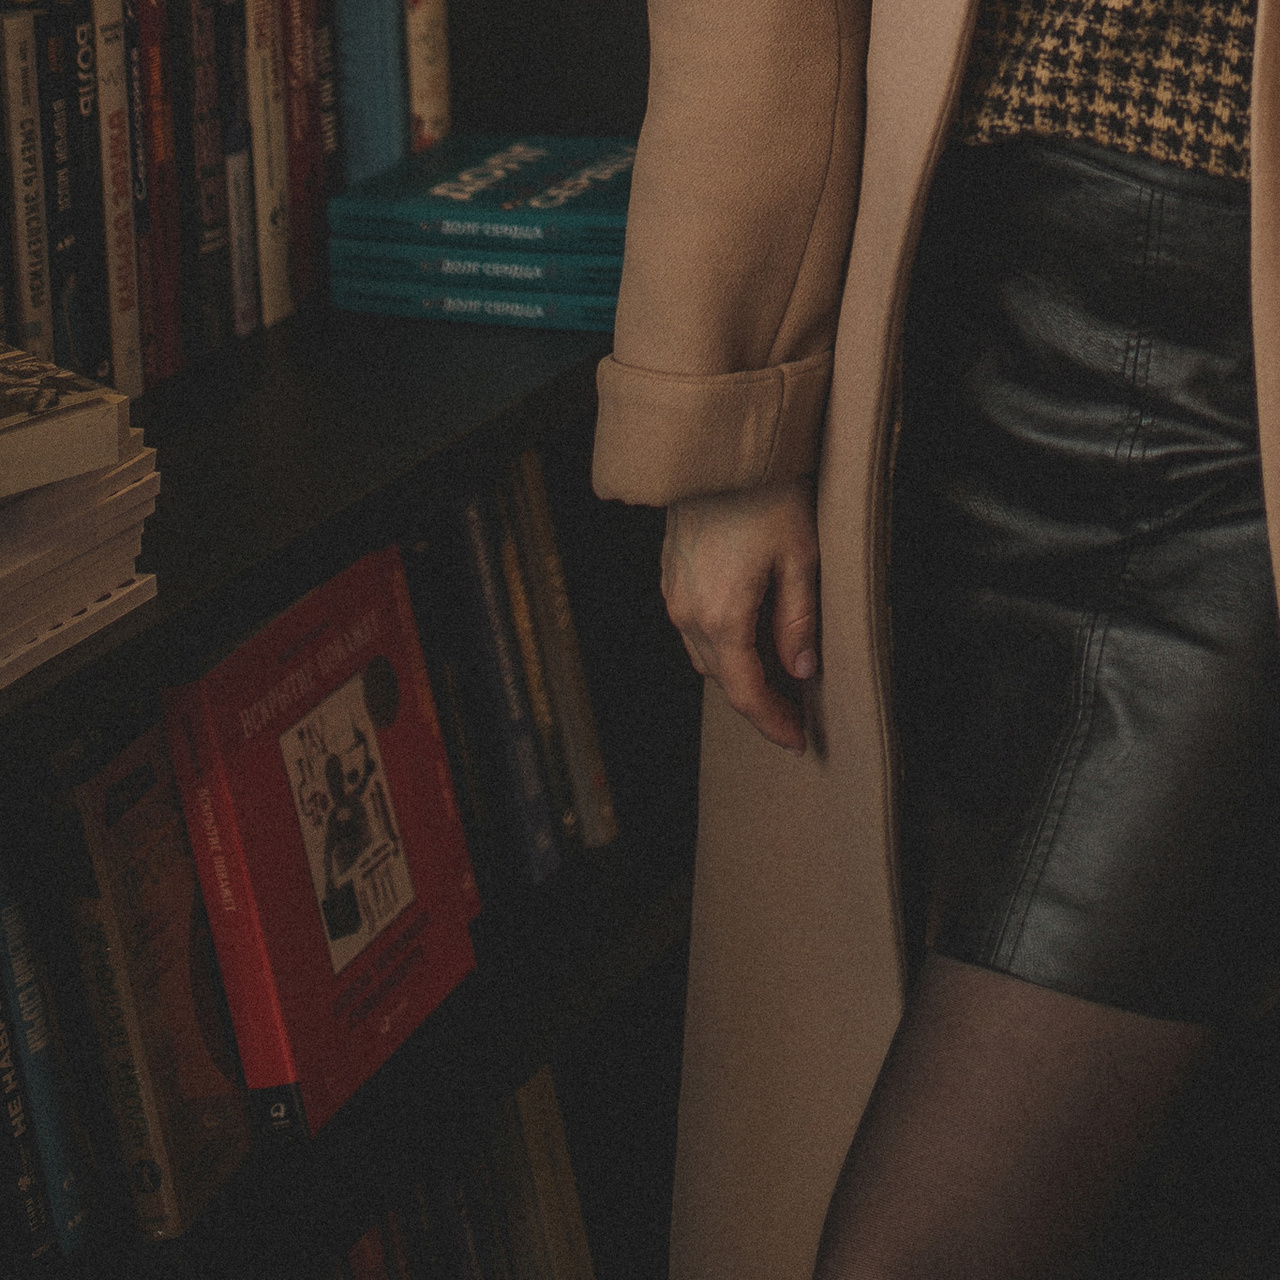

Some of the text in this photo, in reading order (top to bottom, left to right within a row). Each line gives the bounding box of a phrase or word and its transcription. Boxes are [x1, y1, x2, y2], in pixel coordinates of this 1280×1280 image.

[75, 23, 95, 118] БОЛЬ
[19, 117, 46, 308] СМЕРТЬ ЭКСПЕРТИЗЫ
[7, 1095, 27, 1138] НЕ
